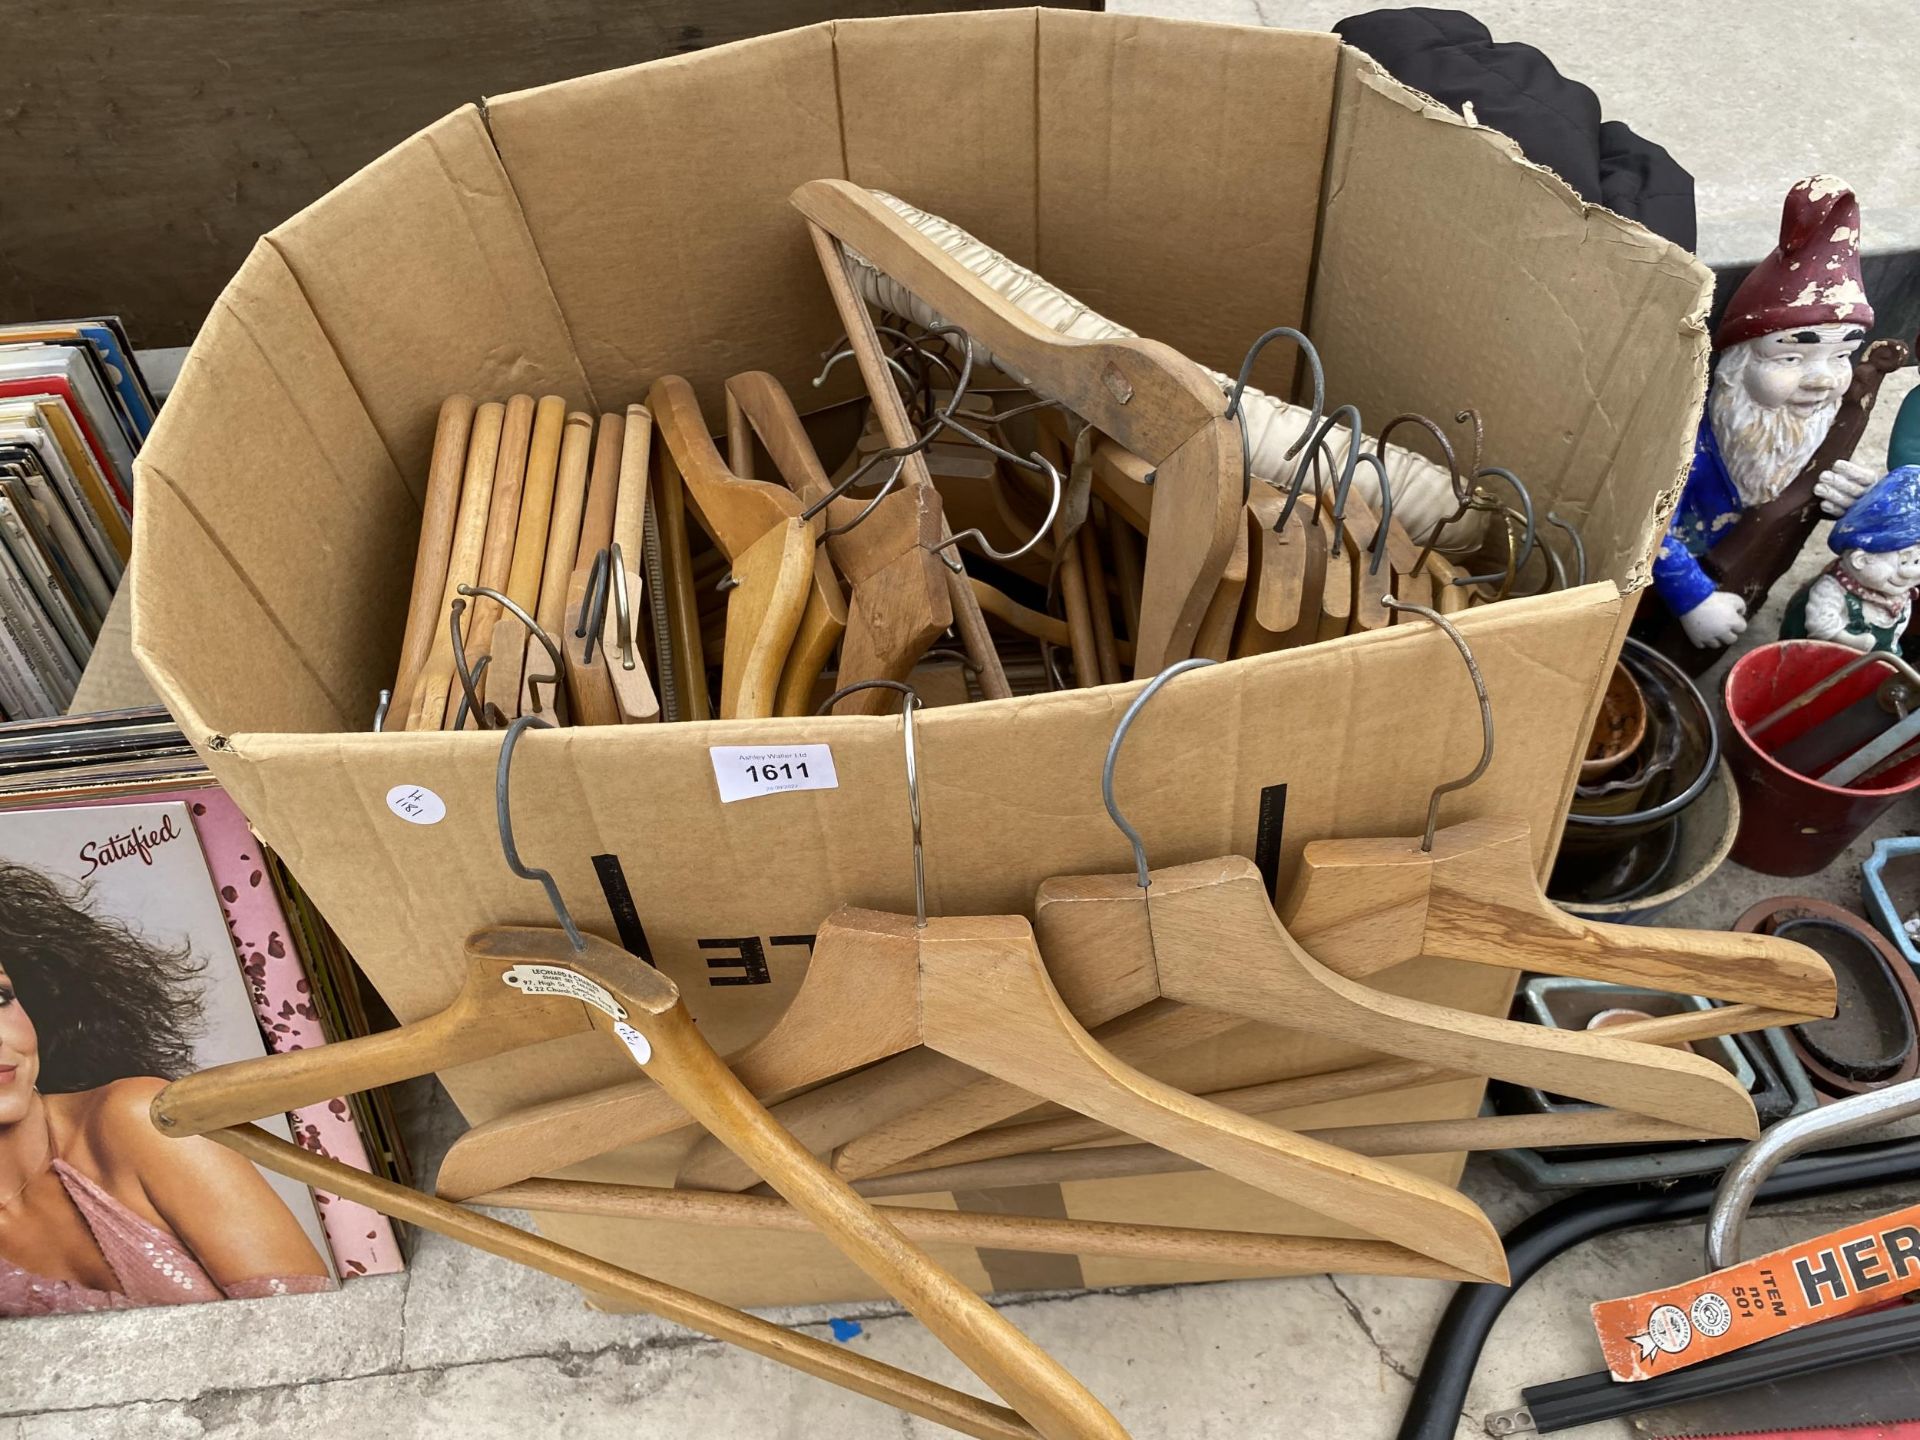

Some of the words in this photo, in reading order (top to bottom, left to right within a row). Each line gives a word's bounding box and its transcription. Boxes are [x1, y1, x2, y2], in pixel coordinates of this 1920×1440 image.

[746, 762, 809, 782] 1611
[79, 814, 182, 880] Satisfied
[1792, 1224, 1920, 1309] HER
[1732, 1286, 1753, 1318] 501
[1760, 1270, 1787, 1316] ITEM
